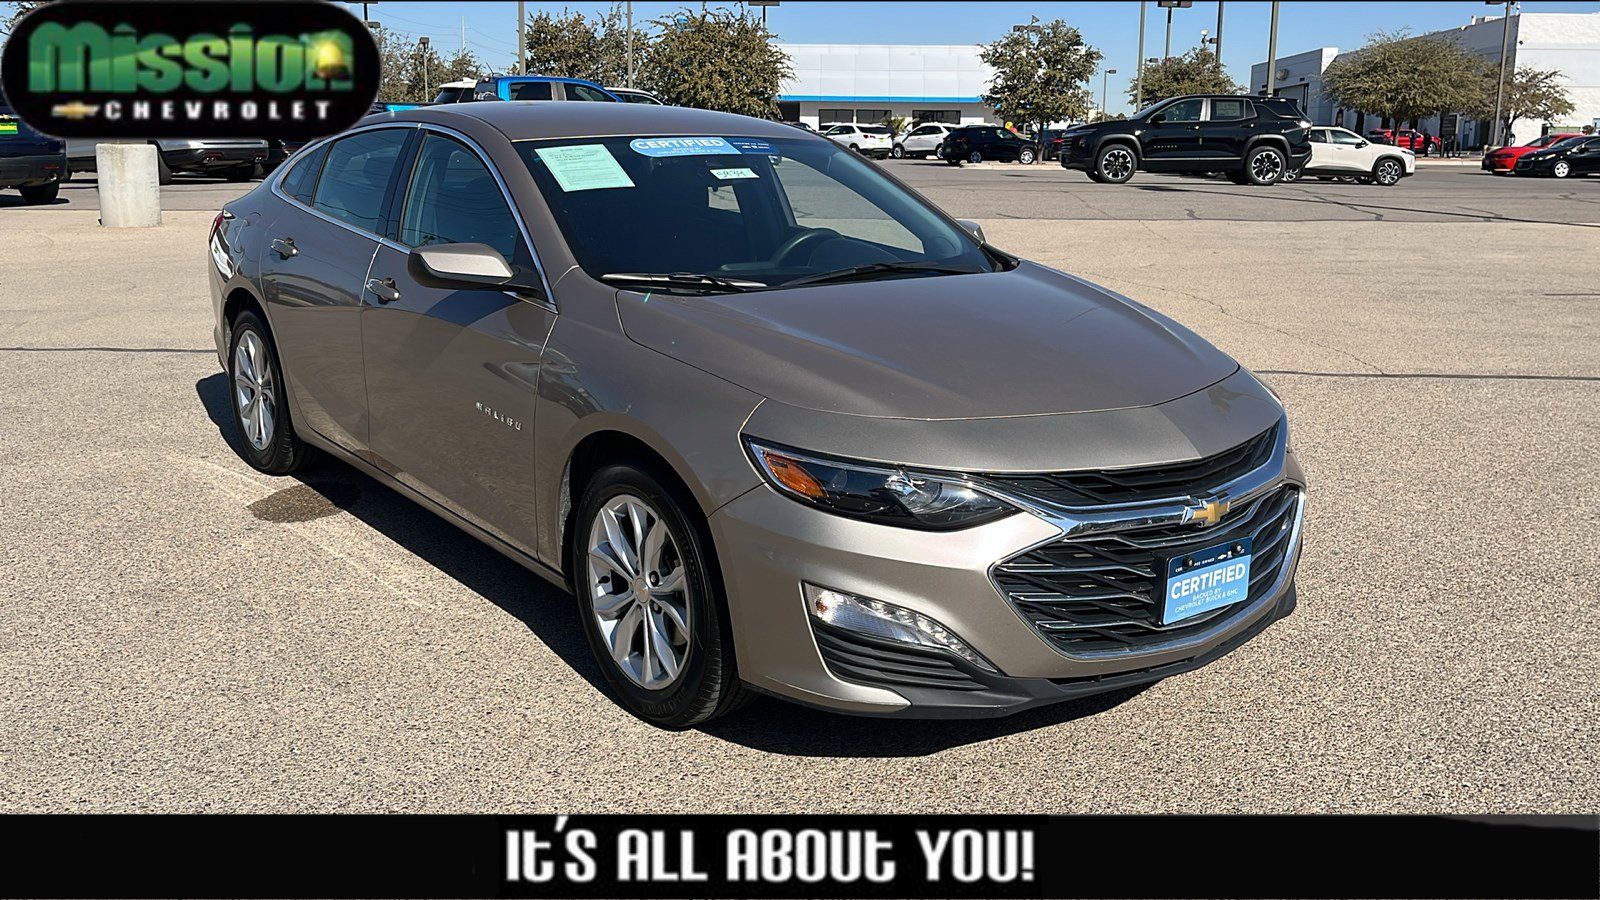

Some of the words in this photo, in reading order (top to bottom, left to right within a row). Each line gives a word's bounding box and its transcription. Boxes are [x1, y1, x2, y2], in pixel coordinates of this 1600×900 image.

[634, 139, 725, 149] CERTIFIED
[1171, 563, 1245, 599] CERTIFIED
[1174, 598, 1205, 613] CHEVROLET
[1205, 593, 1222, 603] BUICK
[1226, 588, 1239, 597] GMC
[1192, 589, 1214, 601] BACKED
[1214, 587, 1222, 595] BY
